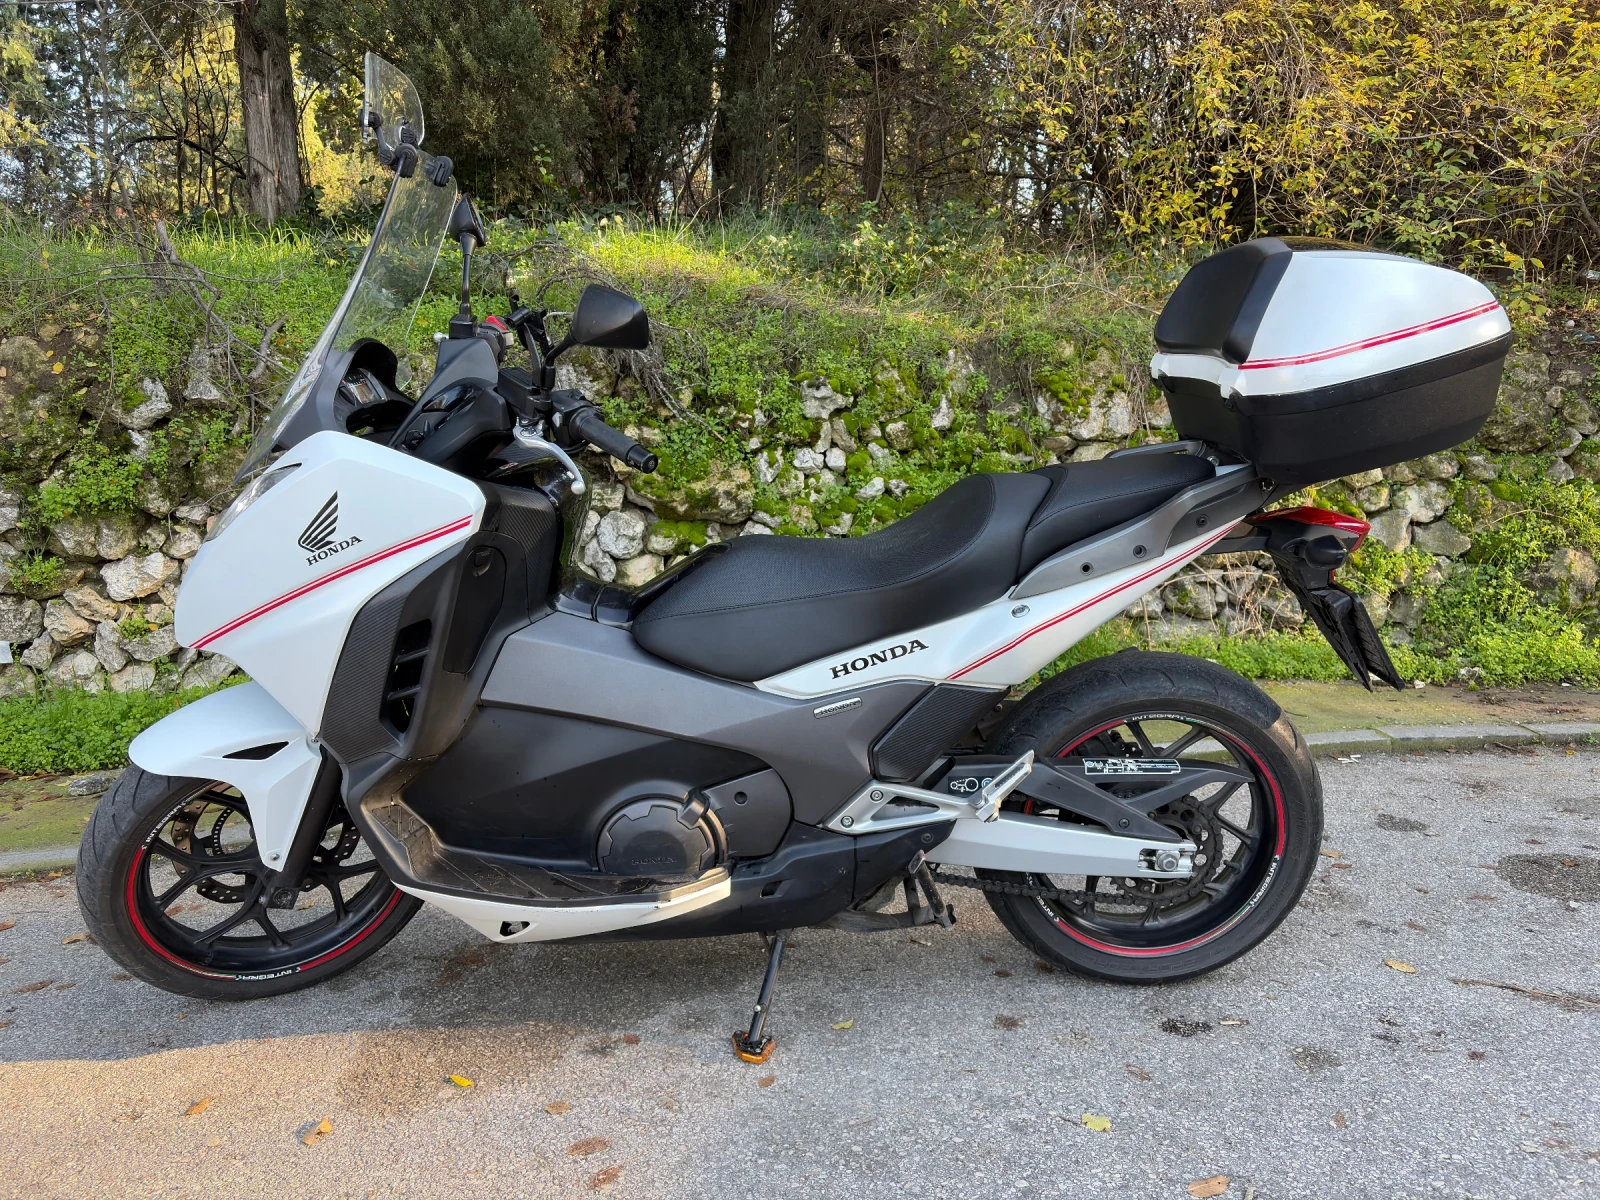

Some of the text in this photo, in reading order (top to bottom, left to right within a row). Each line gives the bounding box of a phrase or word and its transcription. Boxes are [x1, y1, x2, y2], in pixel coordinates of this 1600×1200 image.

[305, 535, 363, 567] HONDA
[828, 639, 929, 680] HONDA
[818, 700, 860, 716] HONDA
[1132, 713, 1180, 721] INTEGRA
[145, 805, 182, 843] INTEGRA
[1253, 862, 1277, 903] INTEGRA
[242, 969, 292, 980] INTEGRA
